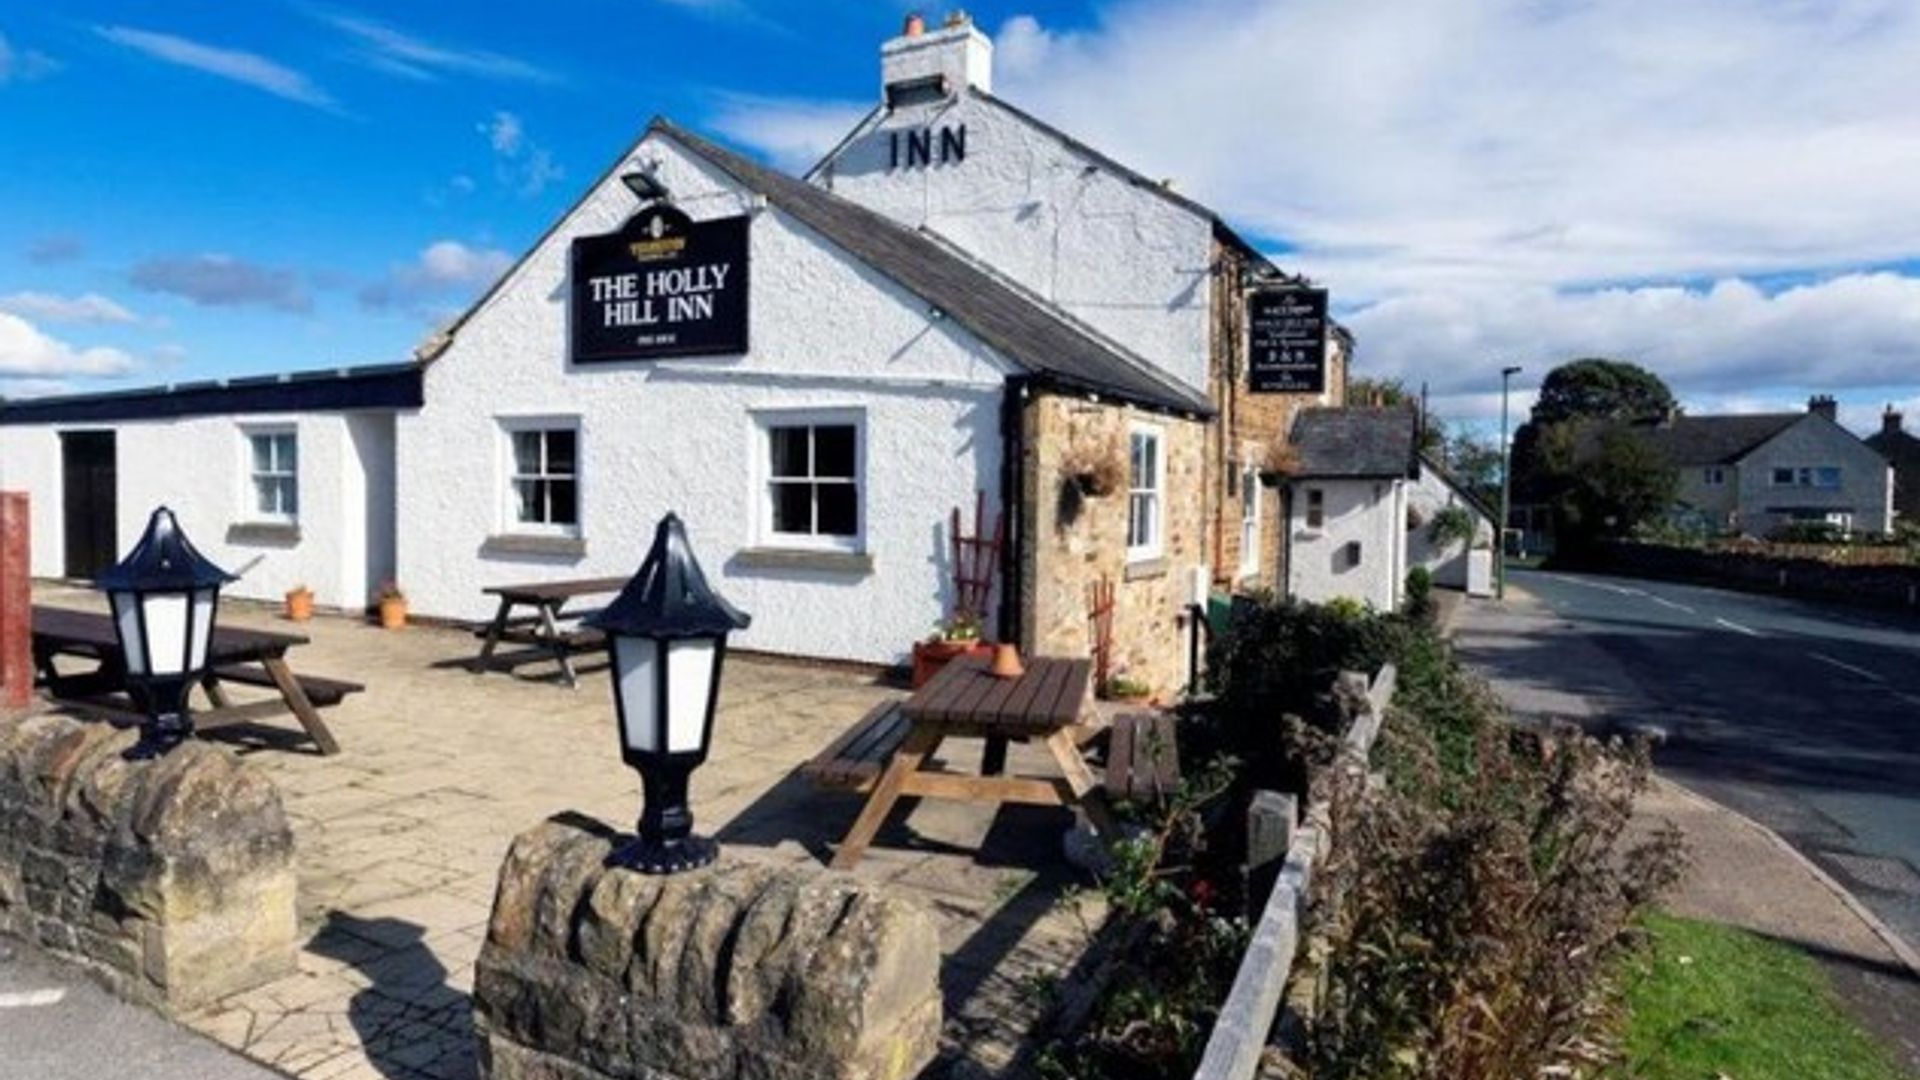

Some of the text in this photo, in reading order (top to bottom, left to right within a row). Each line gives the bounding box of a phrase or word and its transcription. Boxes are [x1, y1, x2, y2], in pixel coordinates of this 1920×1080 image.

[890, 123, 966, 167] INN
[589, 263, 730, 302] THE HOLLY
[603, 293, 713, 327] HILL INN
